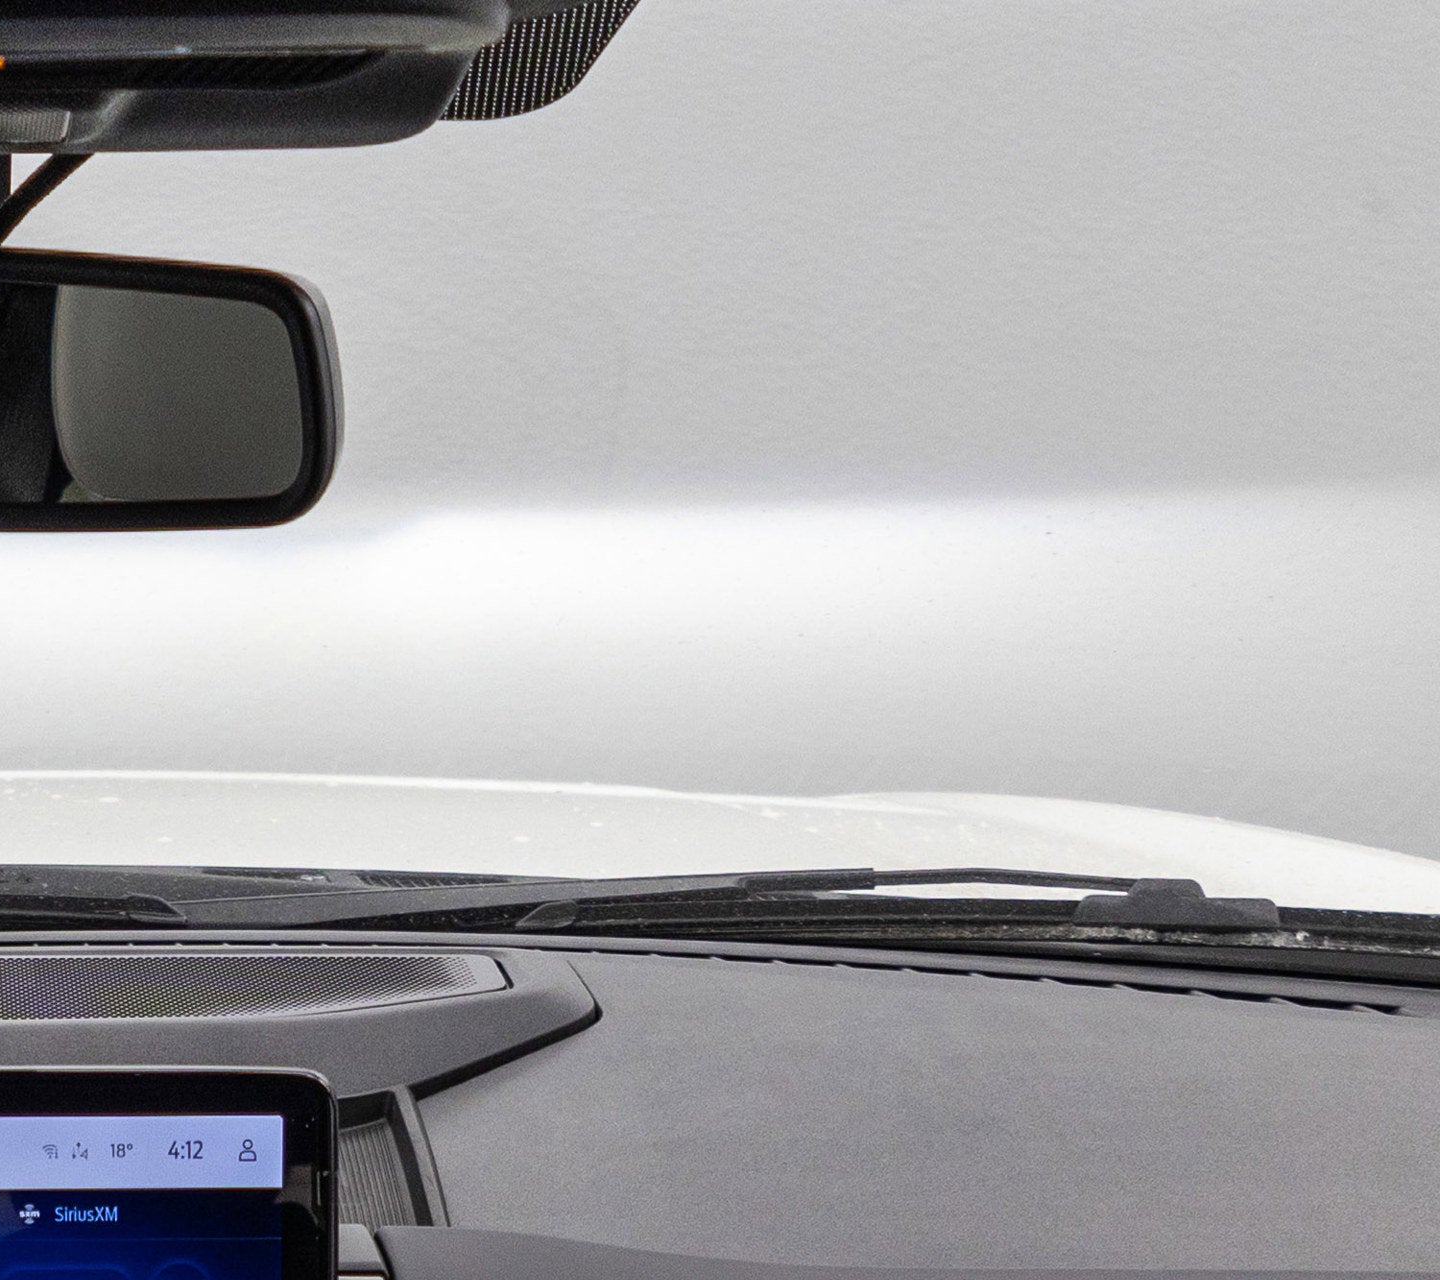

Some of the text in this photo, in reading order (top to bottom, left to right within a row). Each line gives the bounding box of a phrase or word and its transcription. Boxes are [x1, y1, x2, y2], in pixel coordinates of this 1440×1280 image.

[110, 1143, 133, 1158] 18°
[168, 1140, 204, 1160] 4:12
[55, 1206, 118, 1222] SiriusXM
